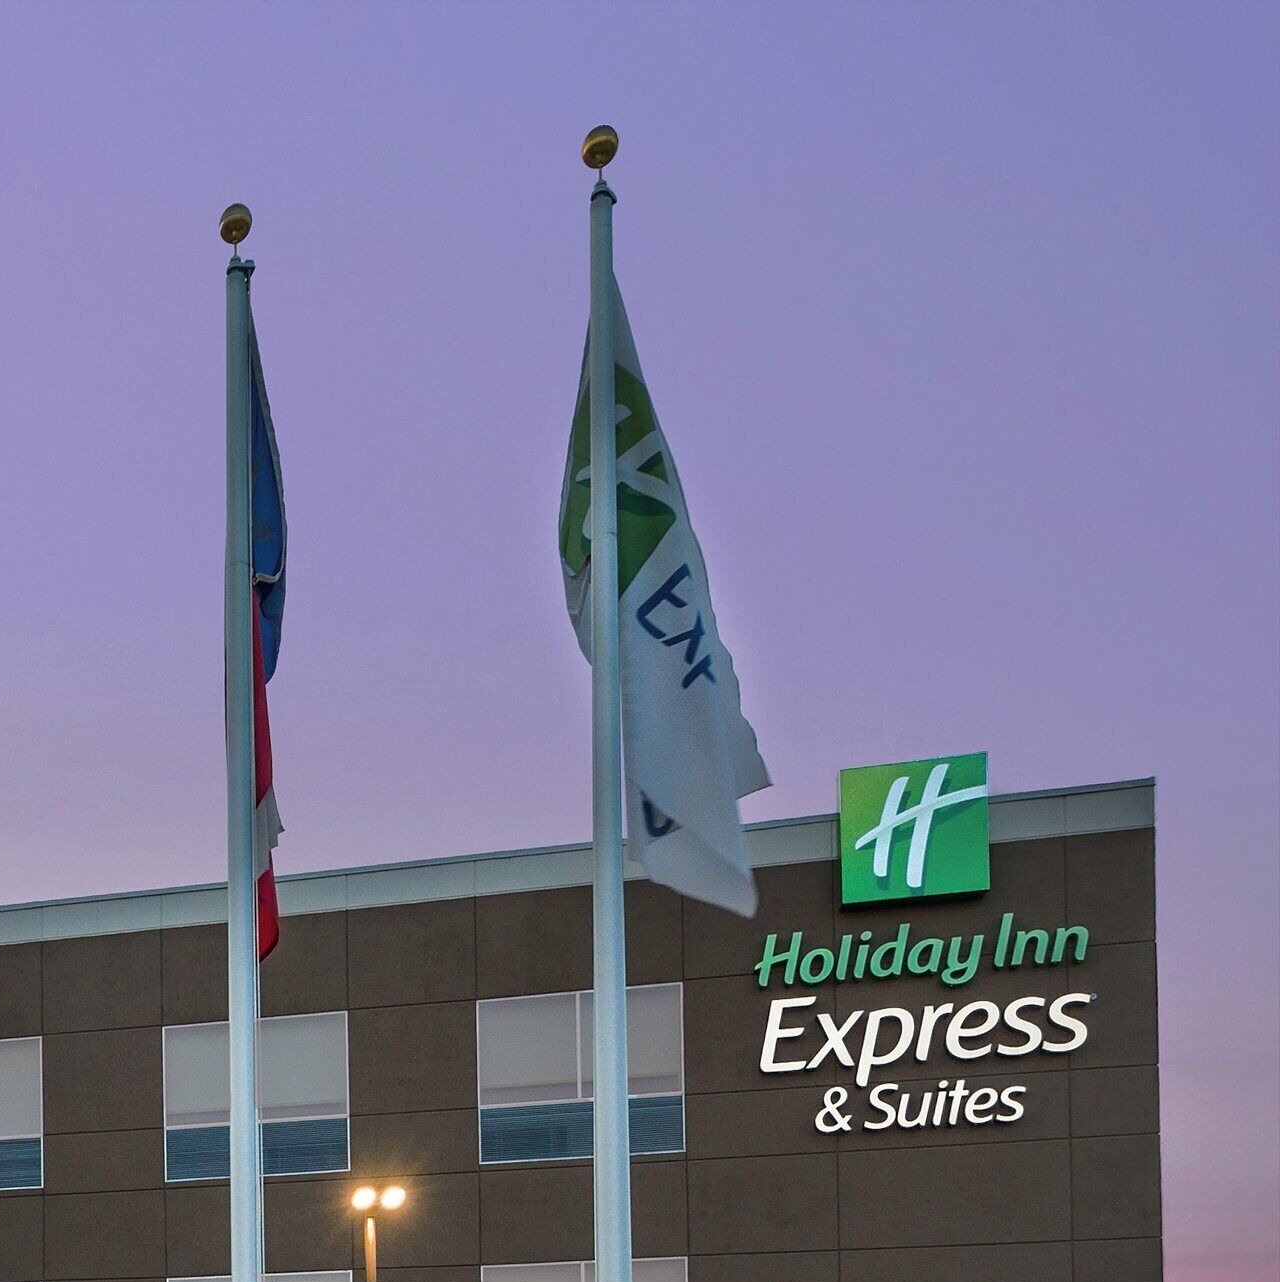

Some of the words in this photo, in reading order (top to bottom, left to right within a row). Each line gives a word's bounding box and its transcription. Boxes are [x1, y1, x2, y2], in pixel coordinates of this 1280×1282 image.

[753, 922, 985, 987] Holiday
[993, 912, 1090, 968] Inn
[759, 992, 1092, 1087] Express
[814, 1085, 853, 1133] &
[863, 1079, 1028, 1130] Suites
